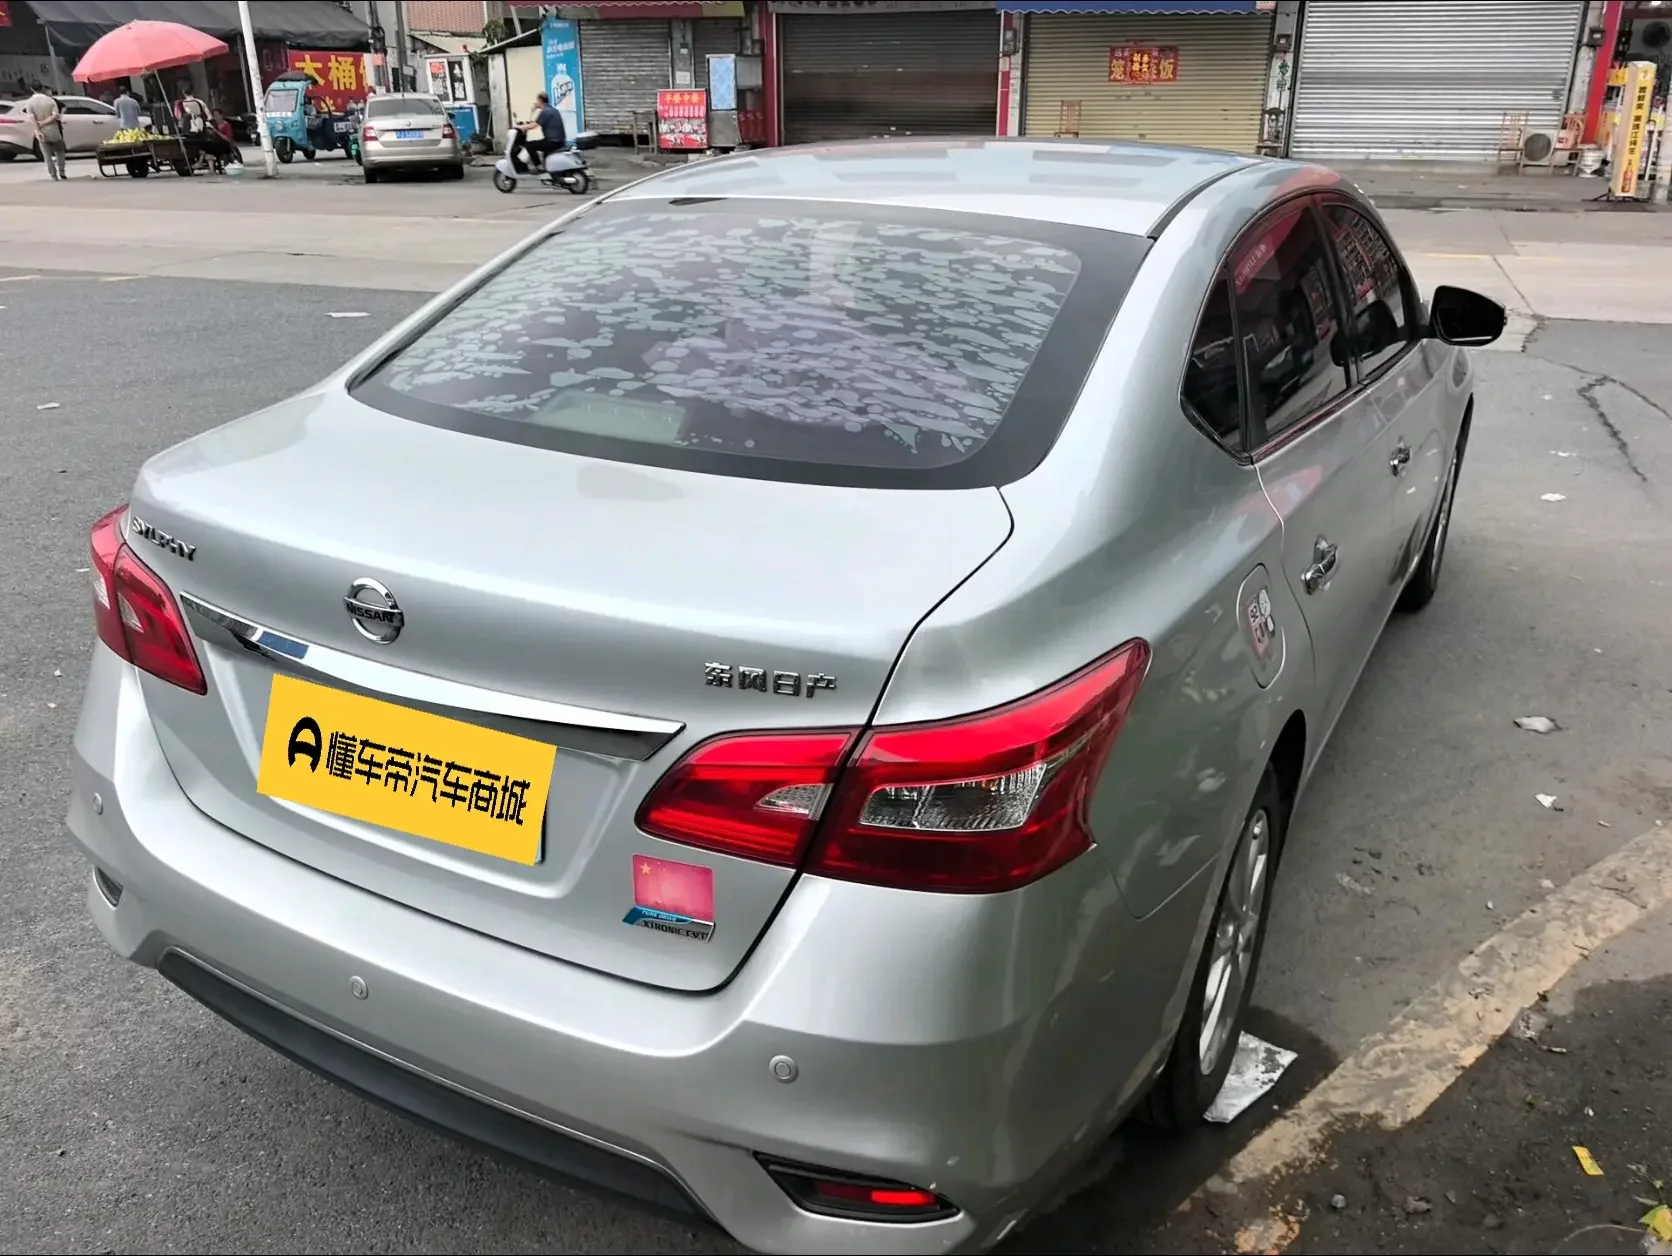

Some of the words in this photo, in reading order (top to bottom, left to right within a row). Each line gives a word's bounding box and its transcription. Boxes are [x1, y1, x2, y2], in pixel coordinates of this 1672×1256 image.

[132, 516, 196, 561] SYLPHY
[346, 600, 396, 624] NISSAN
[704, 660, 838, 698] 东风日产
[643, 920, 684, 935] XTRONIC
[686, 930, 709, 940] CVT
